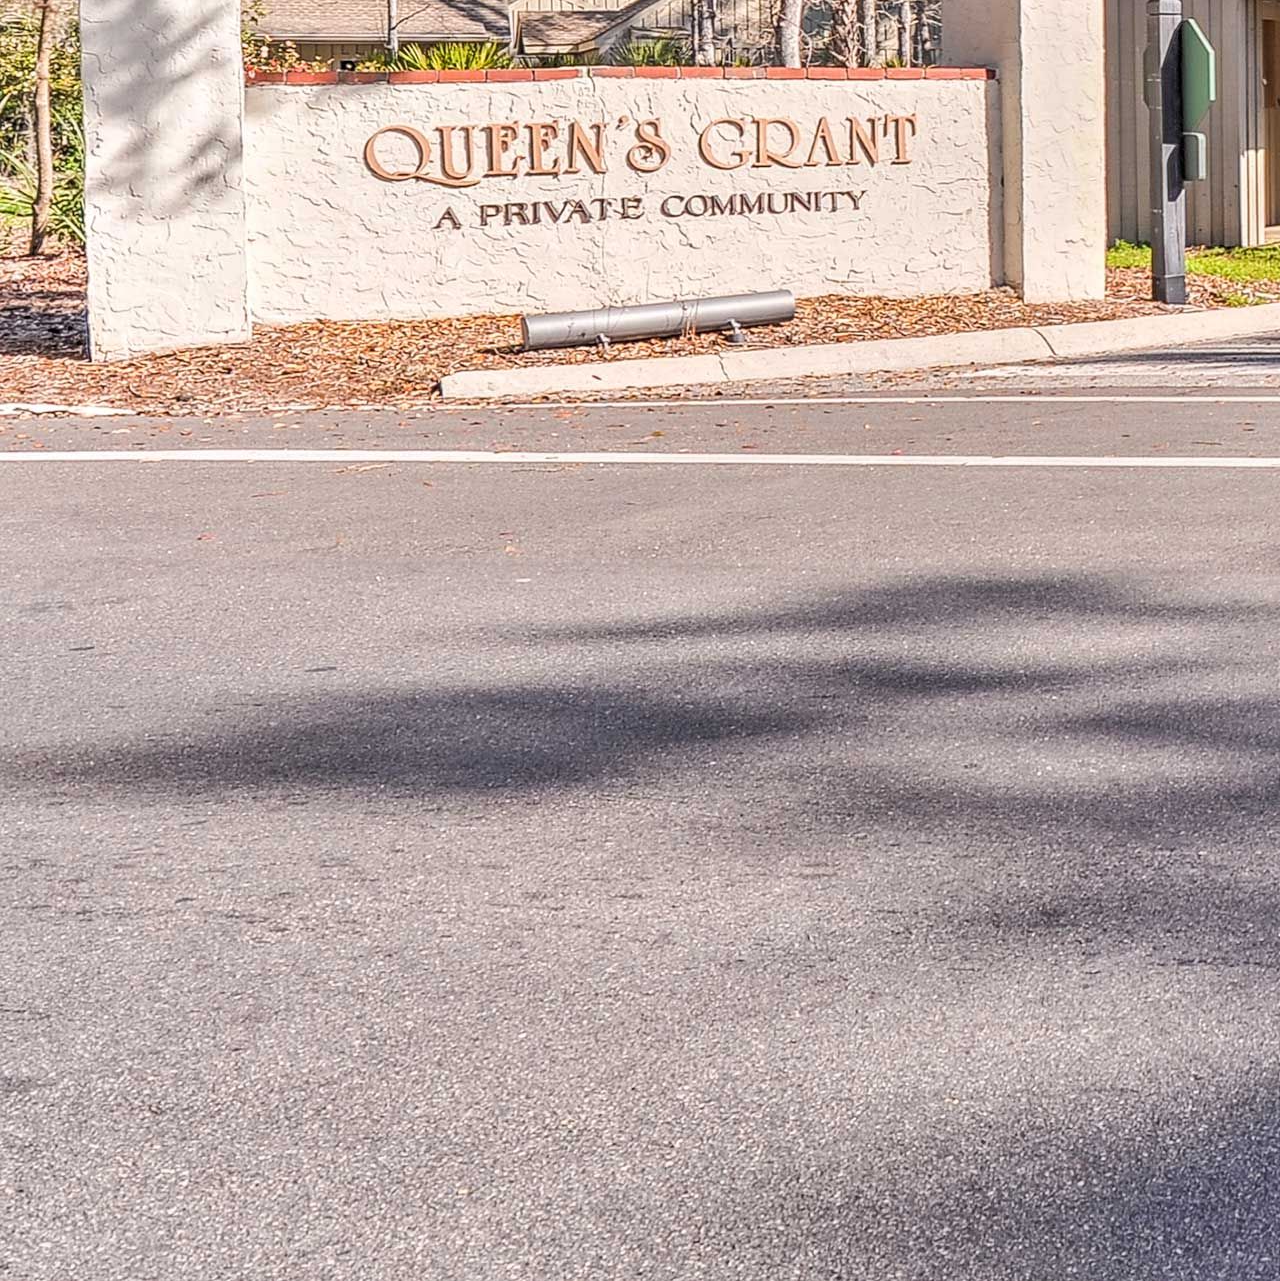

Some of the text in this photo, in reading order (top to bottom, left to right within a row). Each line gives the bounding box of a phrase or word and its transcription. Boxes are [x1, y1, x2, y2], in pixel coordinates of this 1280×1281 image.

[364, 113, 917, 188] QUEEN'S GRANT
[432, 190, 868, 230] A PRIVATE COMMUNITY
